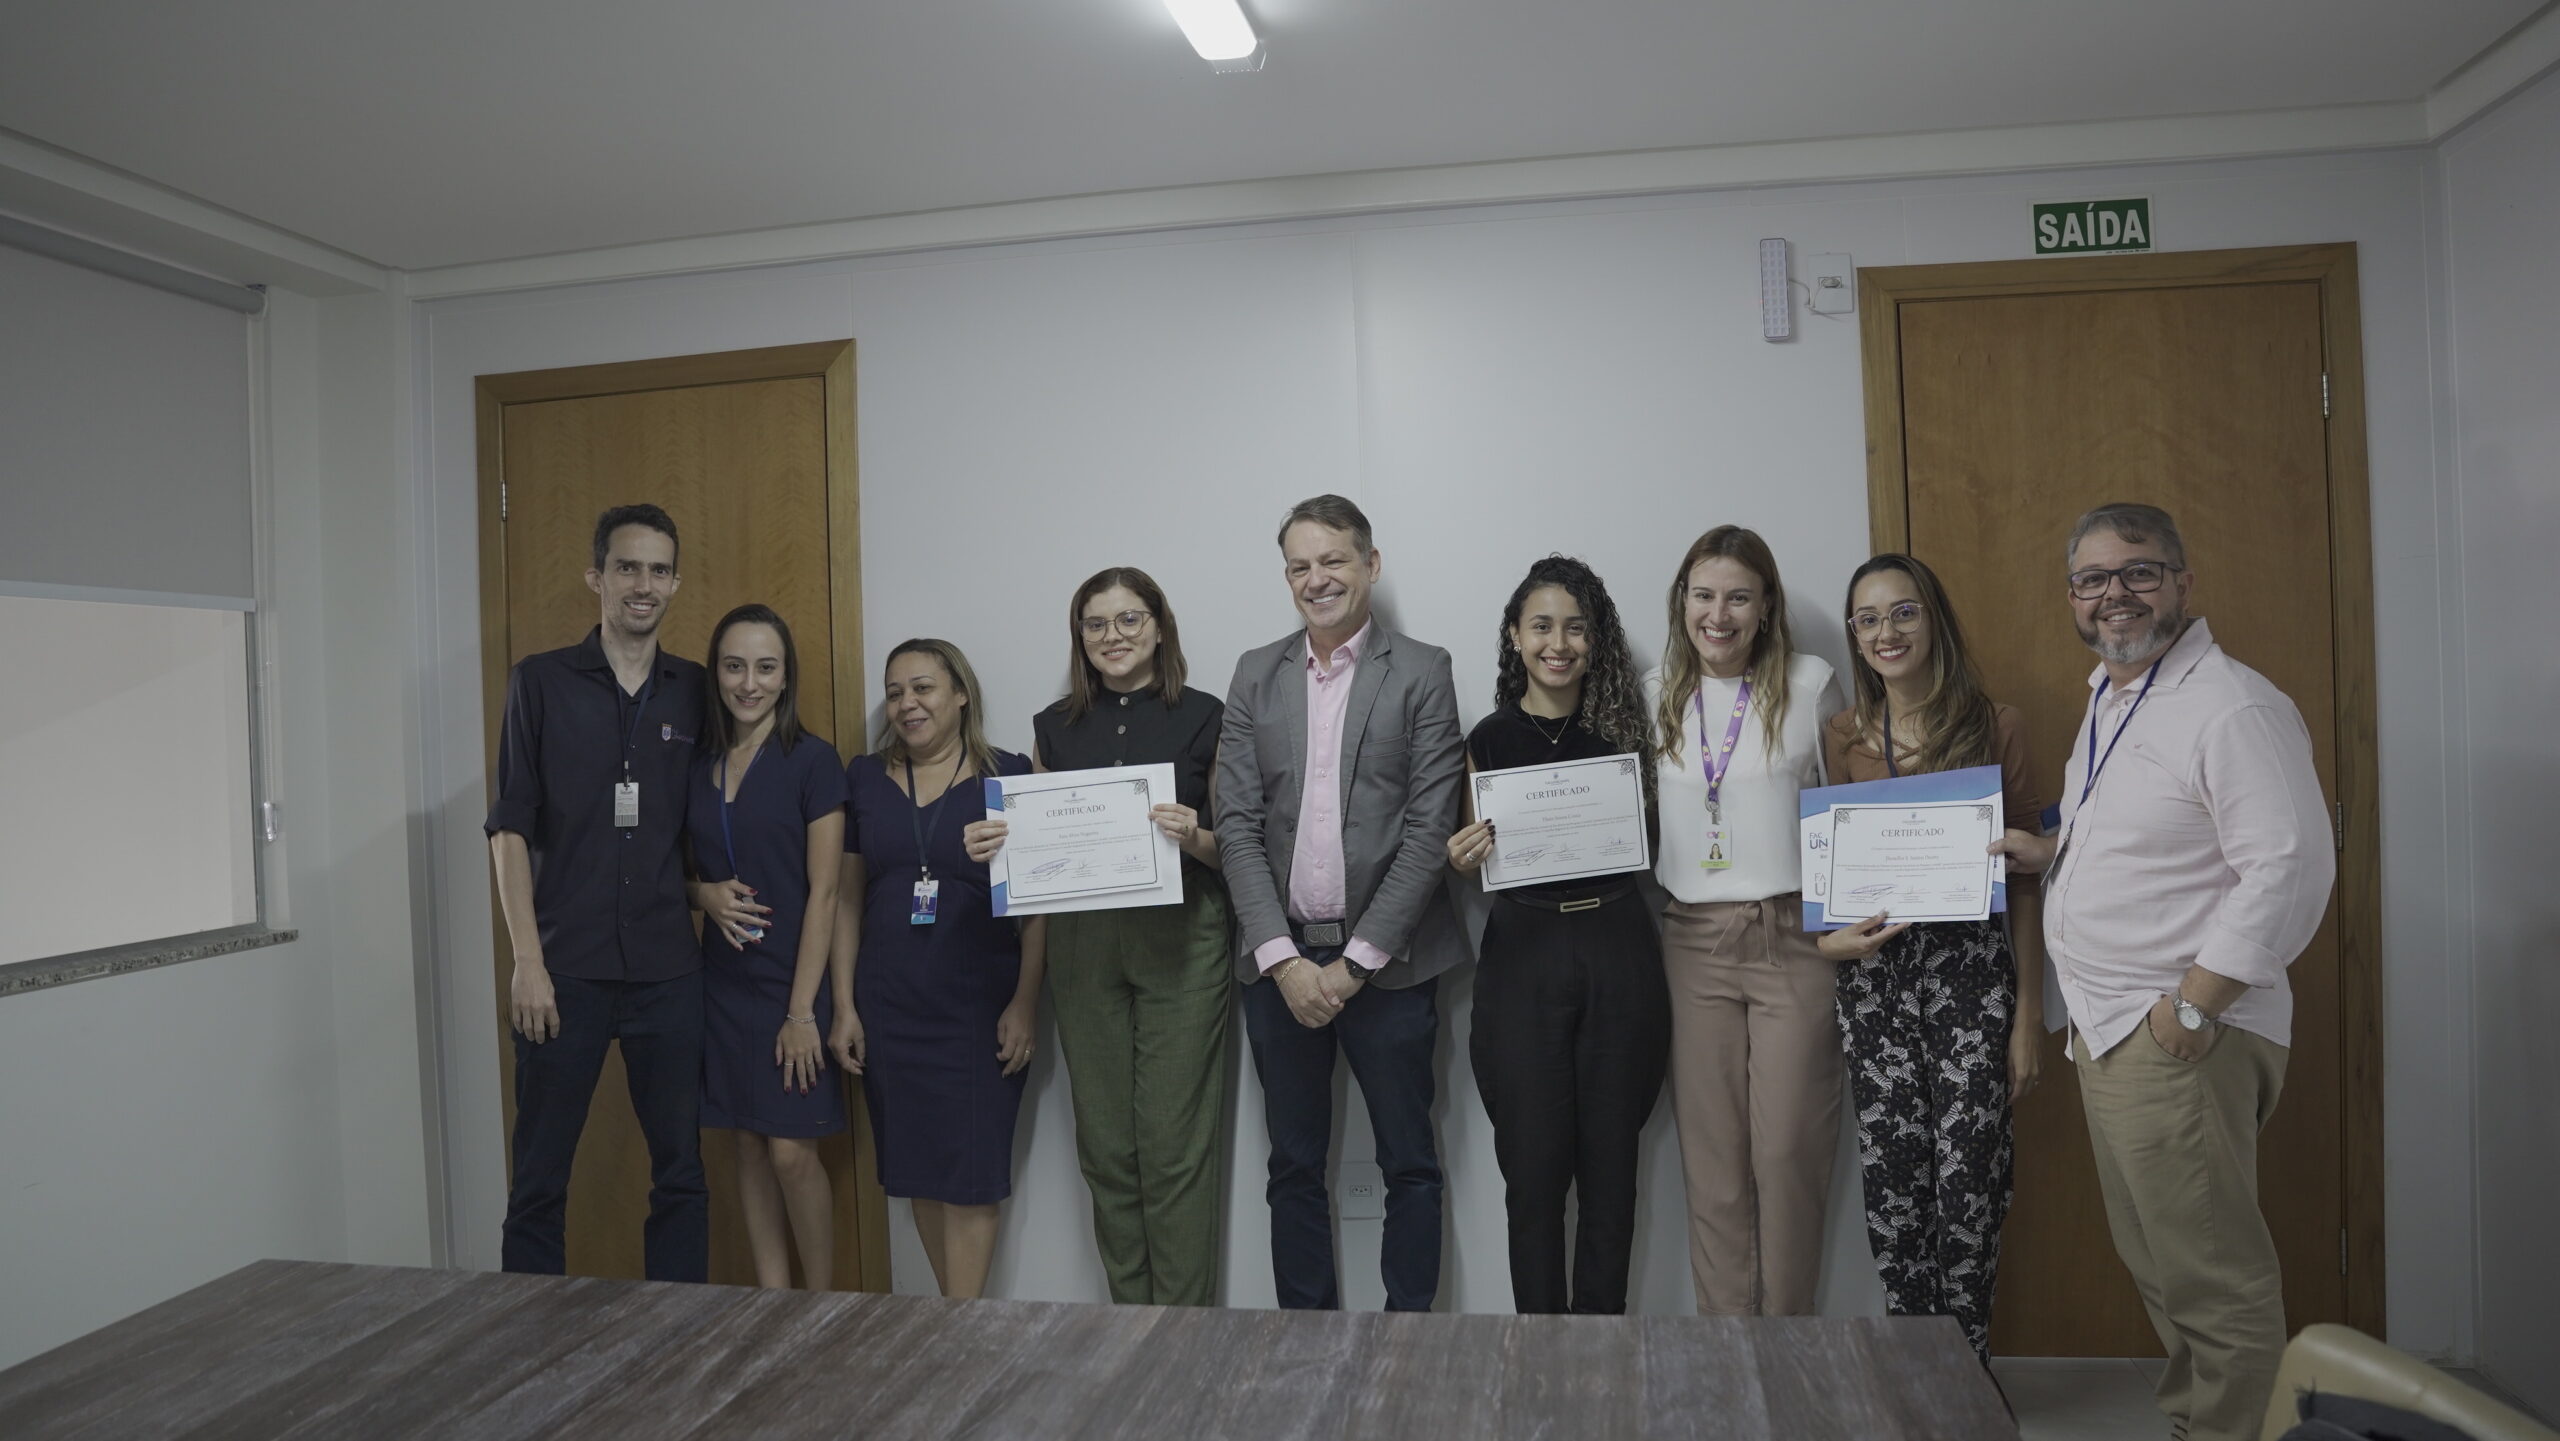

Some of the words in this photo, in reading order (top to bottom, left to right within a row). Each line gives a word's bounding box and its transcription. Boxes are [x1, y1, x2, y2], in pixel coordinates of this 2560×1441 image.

[2038, 202, 2147, 249] SAÍDA
[1526, 785, 1590, 801] CERTIFICADO
[1046, 803, 1106, 818] CERTIFICADO
[1881, 827, 1945, 838] CERTIFICADO
